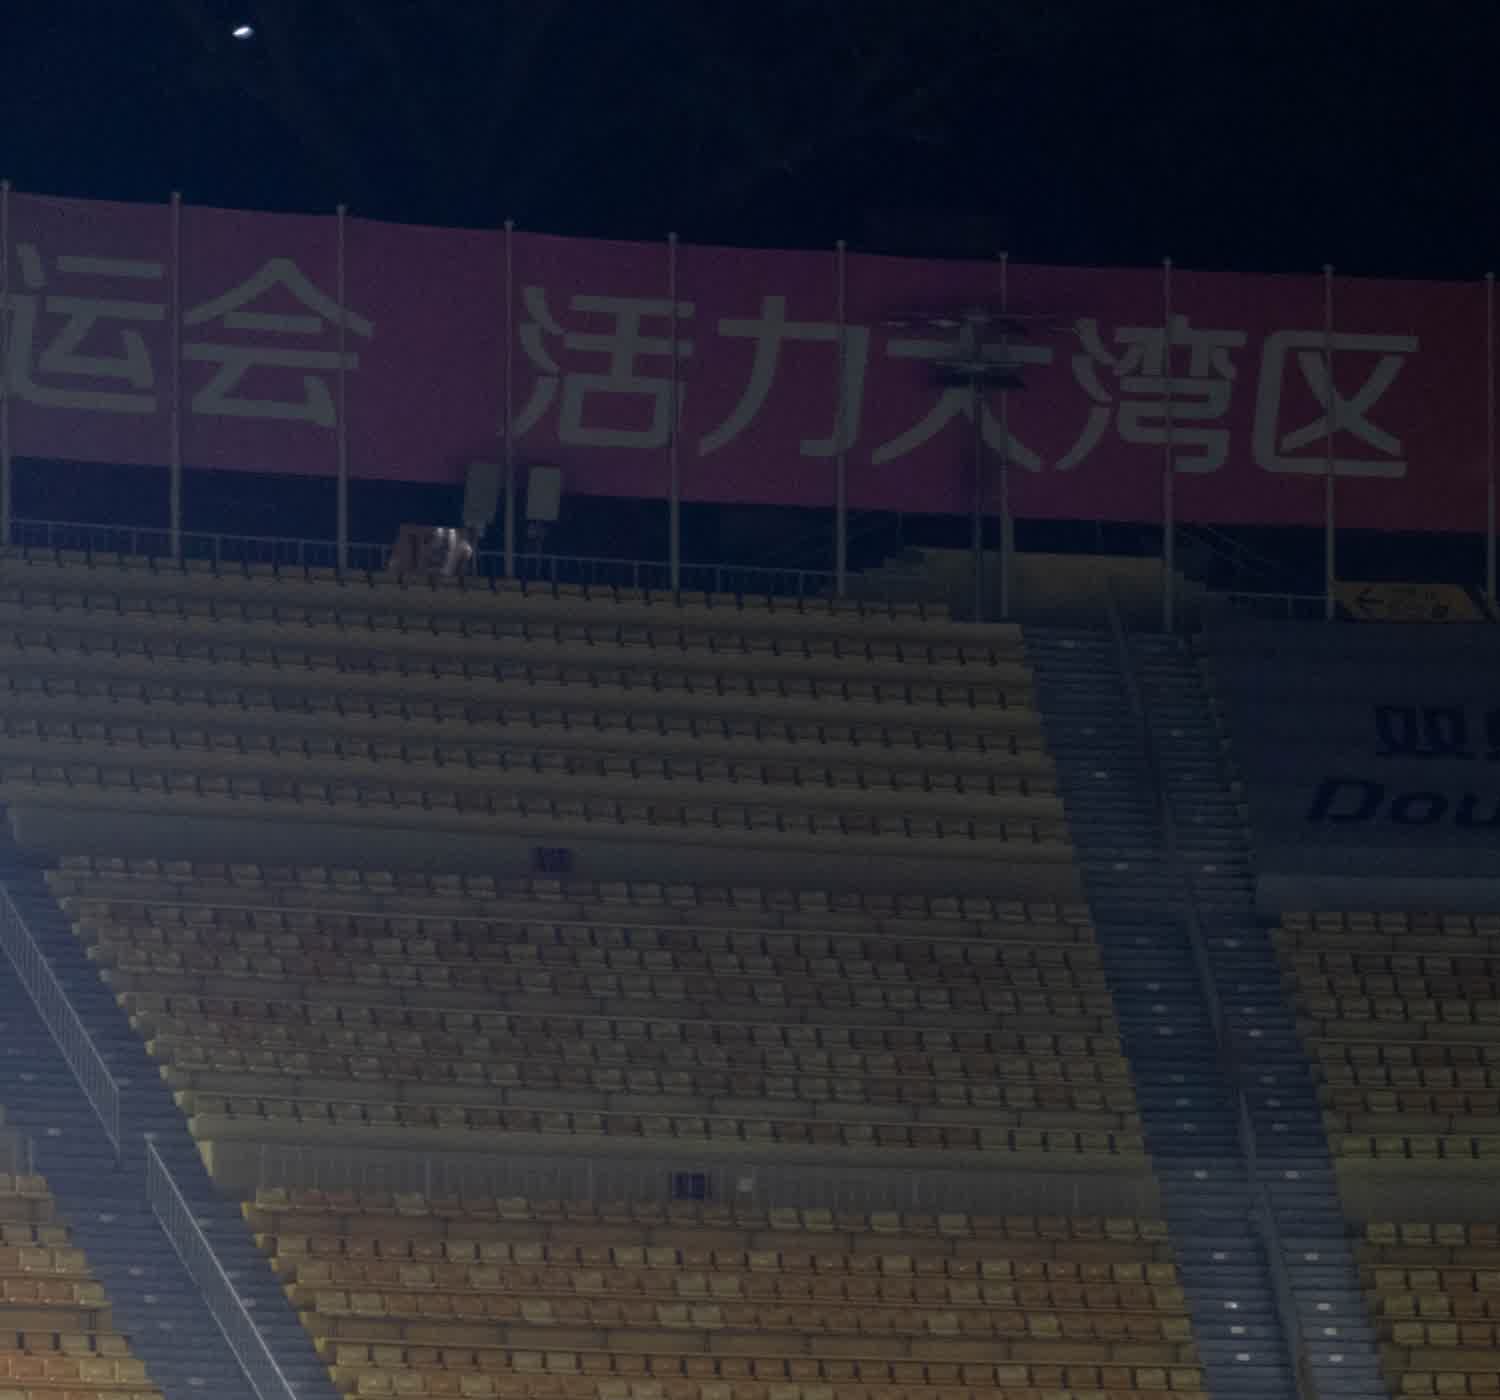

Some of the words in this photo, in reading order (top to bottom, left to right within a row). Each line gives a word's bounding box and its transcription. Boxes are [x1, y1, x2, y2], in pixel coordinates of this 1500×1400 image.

[497, 283, 1419, 479] 活力大湾区
